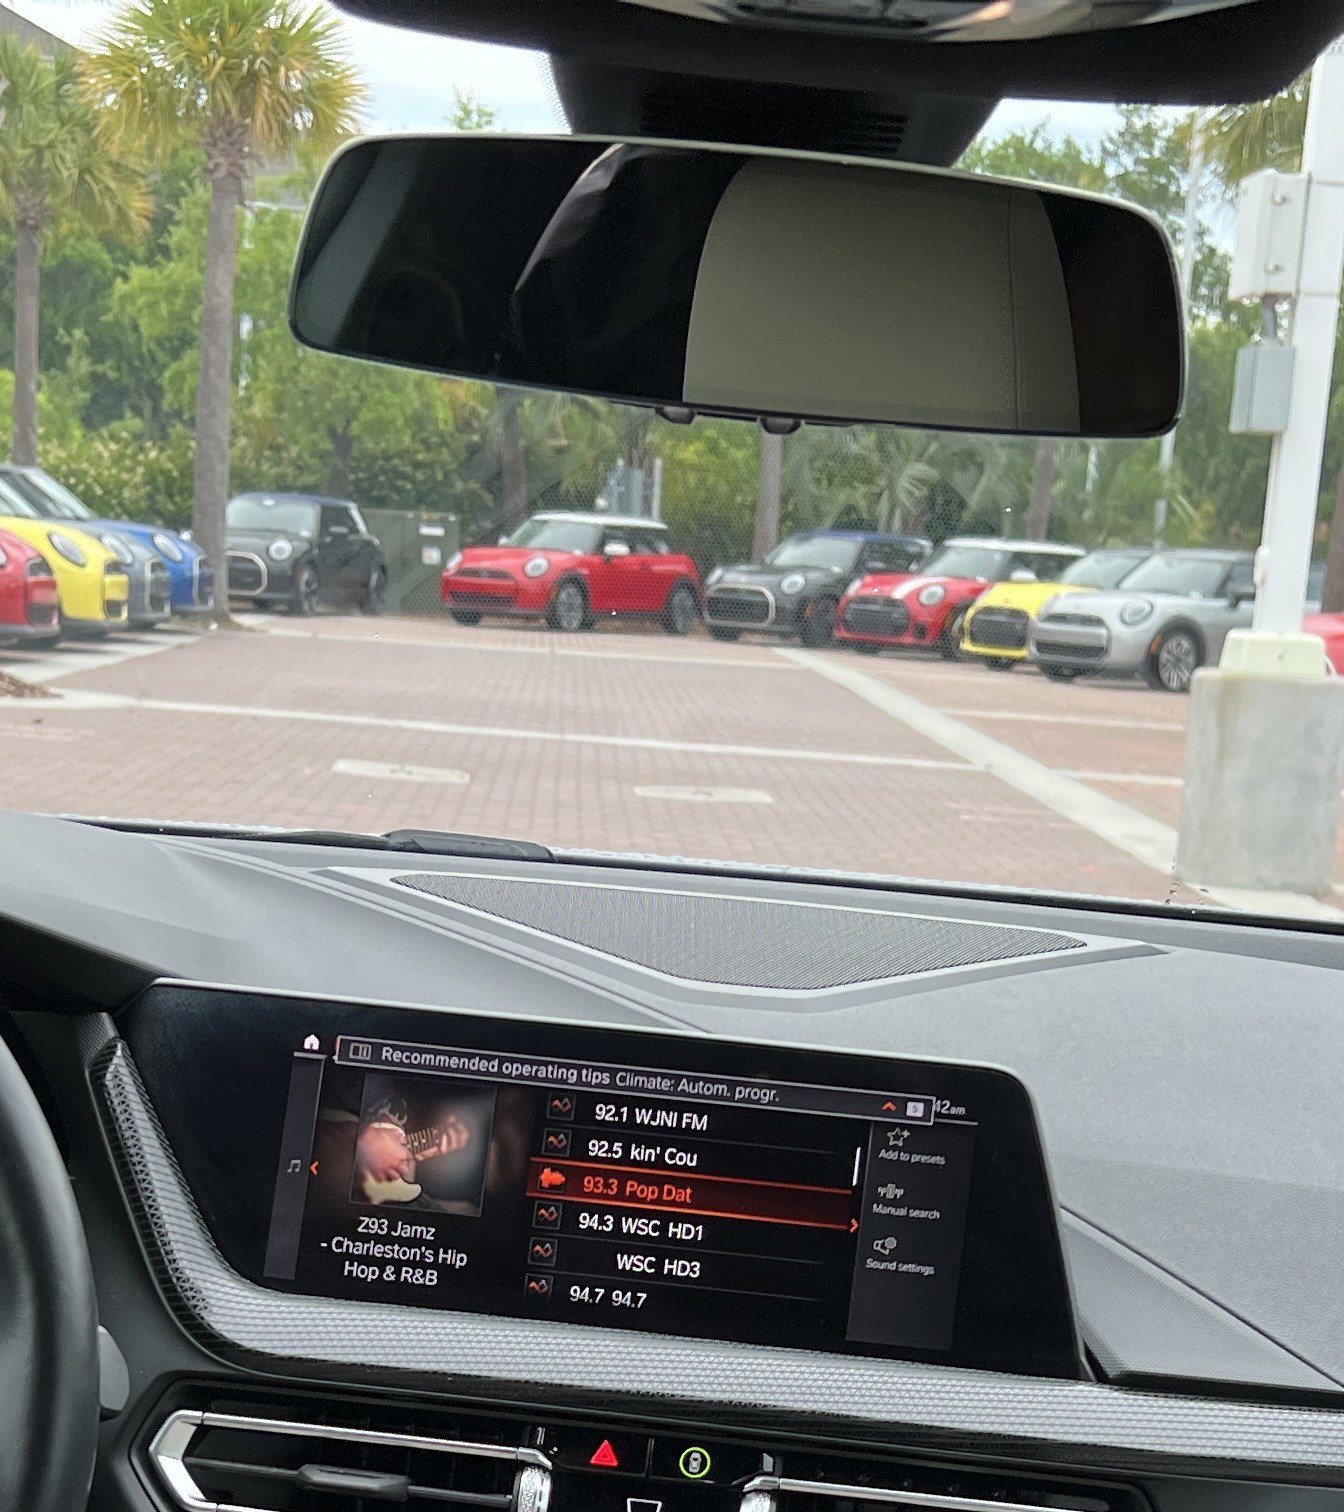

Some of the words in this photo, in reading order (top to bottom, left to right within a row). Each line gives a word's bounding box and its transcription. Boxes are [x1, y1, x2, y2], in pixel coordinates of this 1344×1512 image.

[381, 1047, 498, 1073] Recommended
[502, 1059, 577, 1083] operating
[581, 1068, 610, 1085] tips
[616, 1071, 674, 1092] Climate:
[678, 1078, 731, 1097] Autom.
[734, 1086, 779, 1102] progr.
[595, 1103, 628, 1123] 92.1
[635, 1108, 678, 1128] WJNI
[682, 1113, 708, 1131] FM
[588, 1139, 623, 1159] 92.5
[630, 1143, 660, 1162] kin'
[664, 1148, 697, 1167] Cou
[878, 1148, 898, 1161] Add
[899, 1151, 910, 1162] to
[911, 1153, 946, 1165] presets
[583, 1175, 618, 1196] 93.3
[626, 1180, 658, 1202] Pop
[663, 1184, 693, 1204] Dat
[872, 1203, 907, 1216] Manual
[909, 1207, 940, 1220] search
[357, 1216, 387, 1235] Z93
[391, 1221, 435, 1240] Jamz
[578, 1212, 614, 1232] 94.3
[621, 1216, 660, 1237] WSC
[668, 1221, 703, 1241] HD1
[331, 1236, 434, 1263] Charleston's
[438, 1249, 467, 1268] Hip
[344, 1261, 379, 1282] Hop
[383, 1265, 397, 1281] &
[400, 1267, 438, 1286] R&B
[617, 1253, 656, 1273] WSC
[663, 1258, 700, 1278] HD3
[865, 1258, 897, 1271] Sound
[898, 1262, 935, 1276] settings
[570, 1285, 604, 1304] 94.7
[611, 1290, 647, 1309] 94.7
